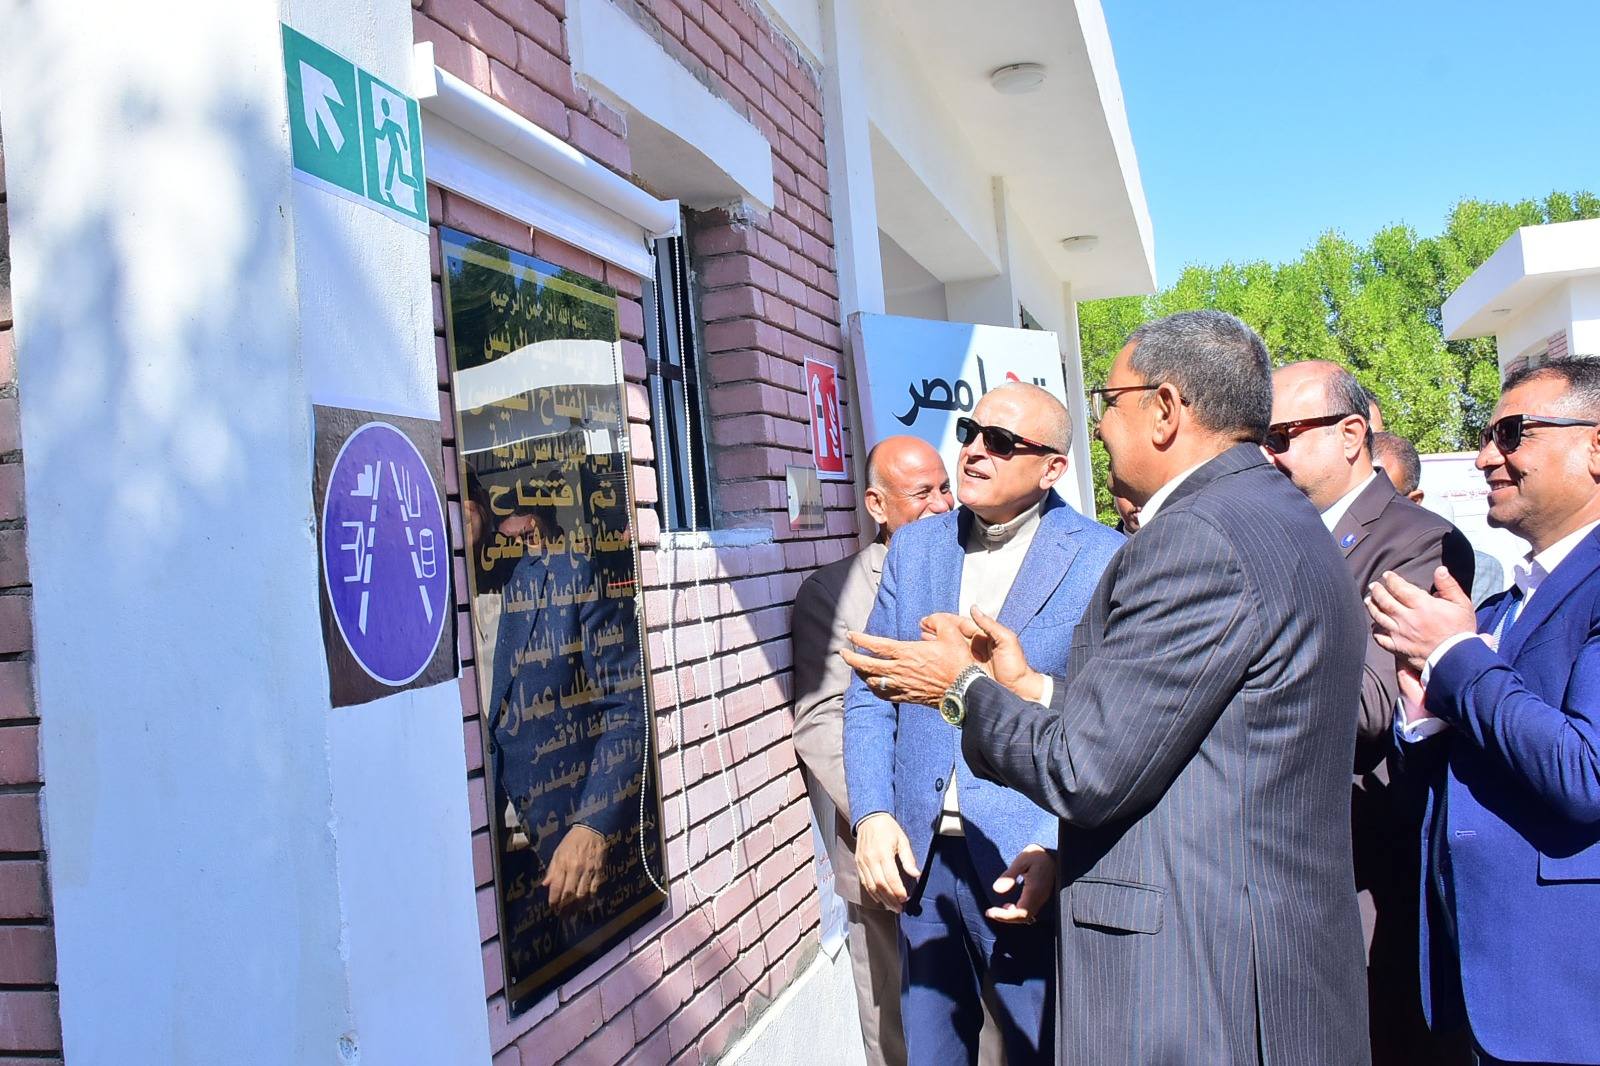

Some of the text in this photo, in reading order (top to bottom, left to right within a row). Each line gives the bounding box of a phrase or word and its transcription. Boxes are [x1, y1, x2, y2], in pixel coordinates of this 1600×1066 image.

[491, 291, 524, 315] الرحيم
[559, 304, 571, 325] الله
[539, 384, 589, 425] الفتاح
[891, 378, 974, 427] مصر
[488, 477, 617, 516] تم افتتاح
[527, 518, 566, 566] صرف
[569, 518, 593, 569] رفع
[592, 519, 632, 553] محطة
